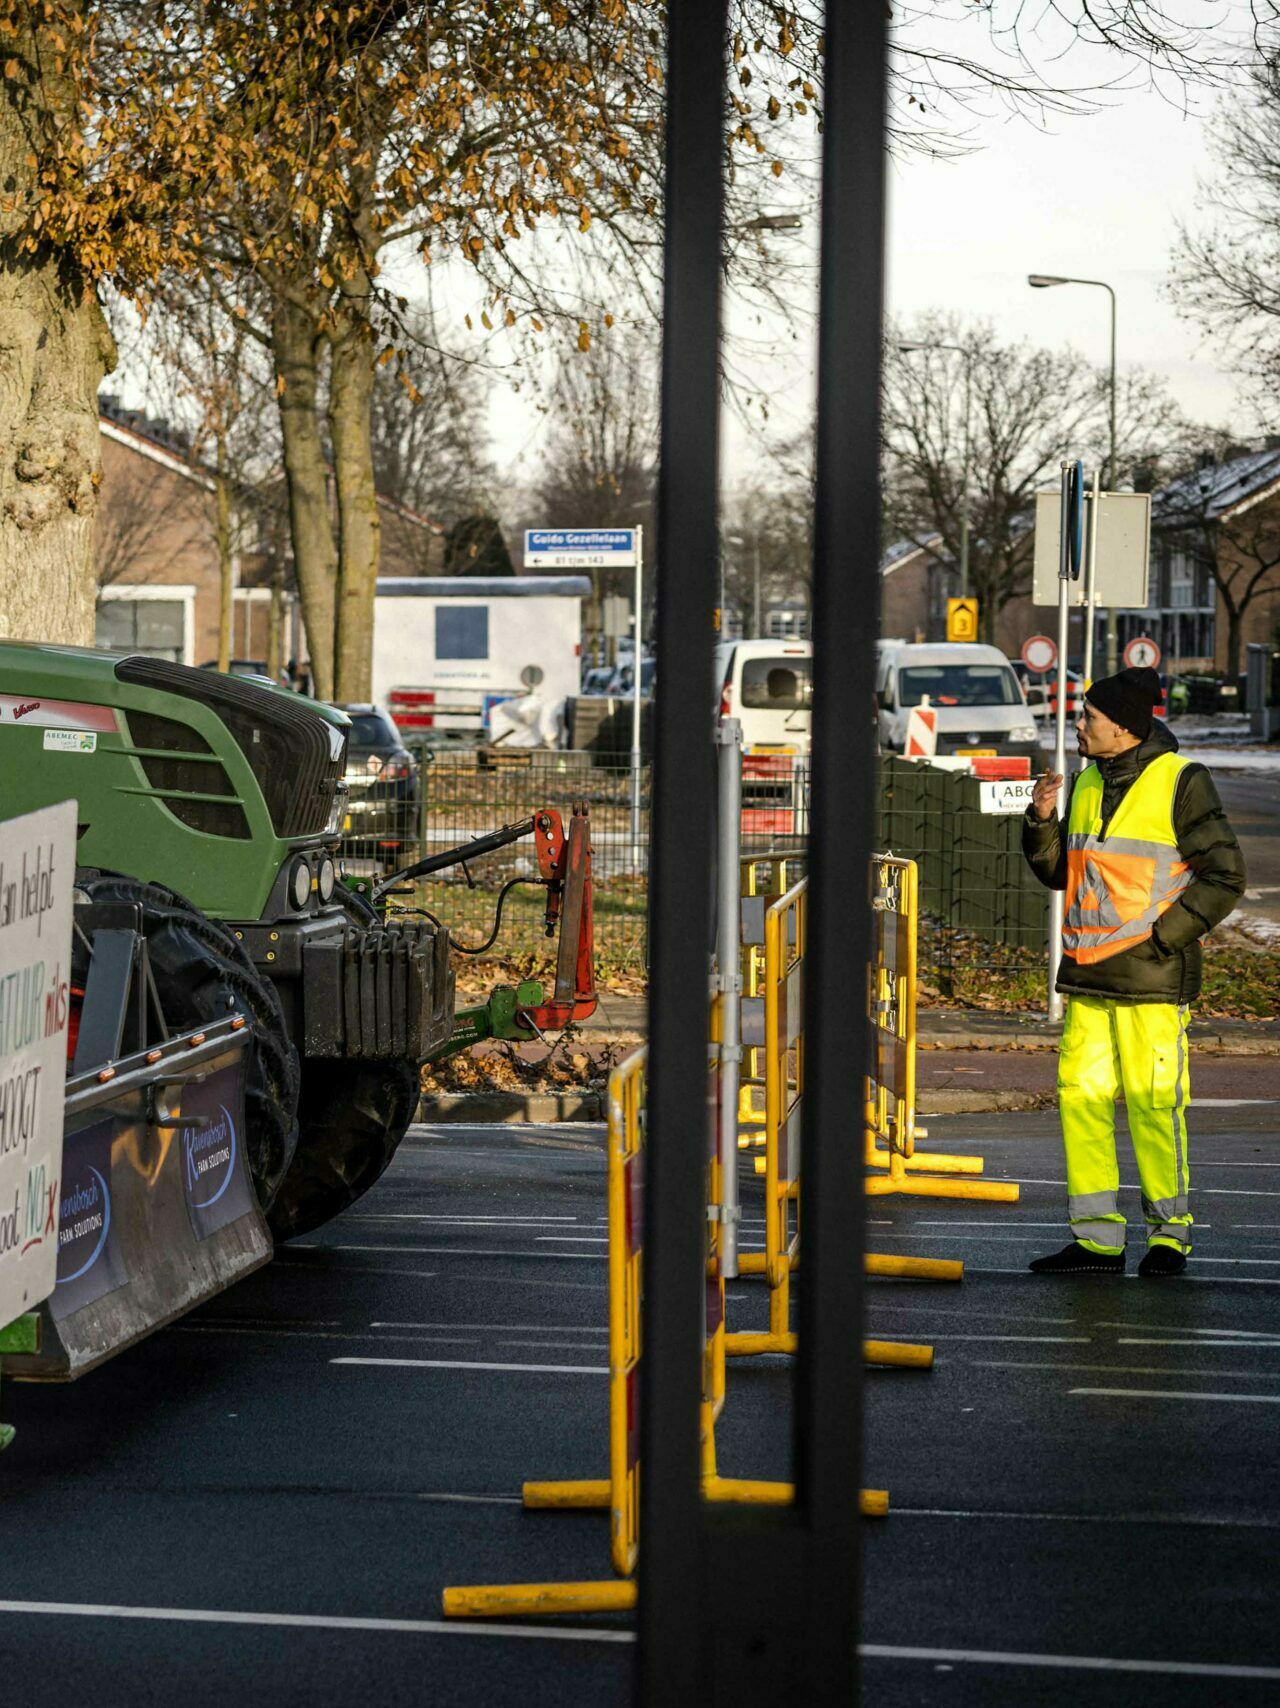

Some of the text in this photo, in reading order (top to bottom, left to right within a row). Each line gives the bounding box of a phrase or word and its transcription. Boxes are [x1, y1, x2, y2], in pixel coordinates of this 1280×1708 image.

[532, 533, 628, 544] Guido Gezellelaan
[20, 843, 55, 938] helpt
[43, 960, 67, 1038] niks
[197, 1146, 231, 1174] FARM SOLUTIONS
[59, 1212, 103, 1246] FARM SOLUTIONS
